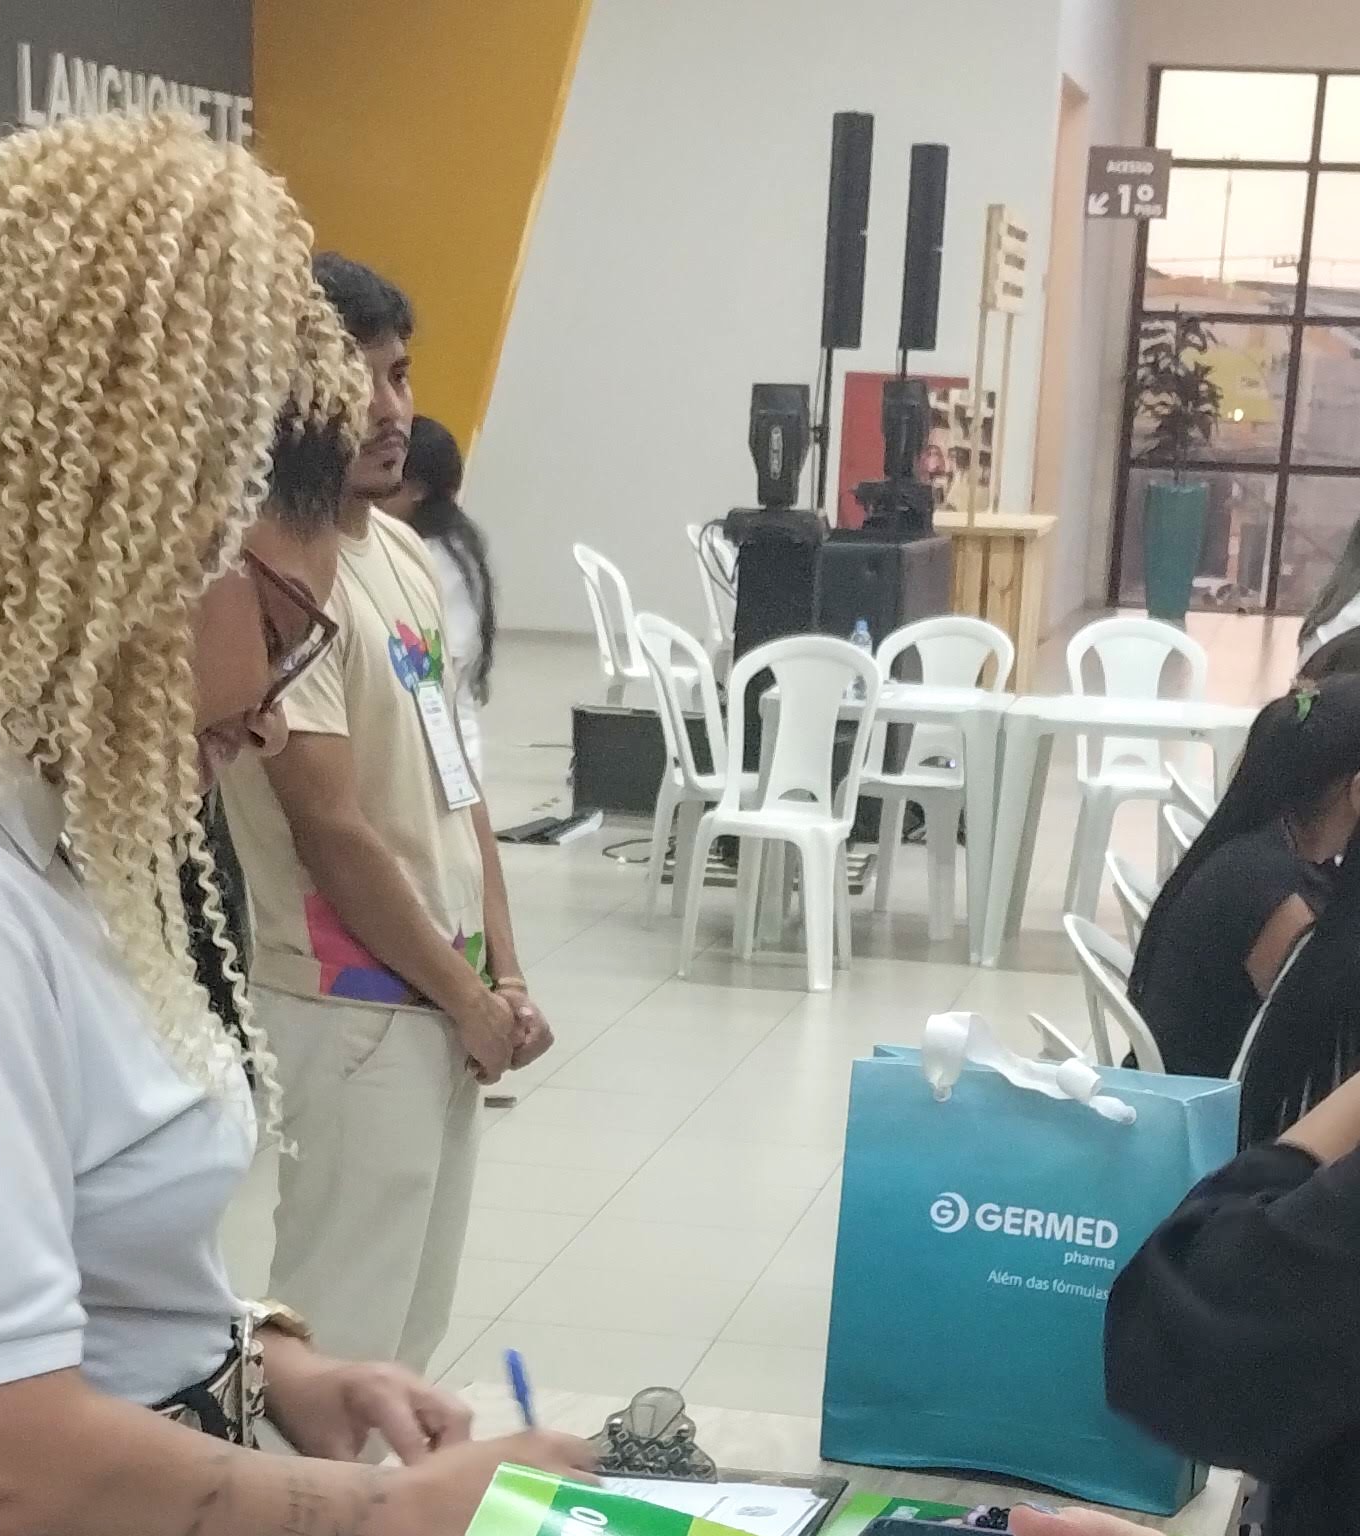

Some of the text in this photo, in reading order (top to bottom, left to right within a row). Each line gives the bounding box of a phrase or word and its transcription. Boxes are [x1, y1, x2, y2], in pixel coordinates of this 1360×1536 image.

[975, 1202, 1119, 1249] GERMED
[1064, 1251, 1116, 1270] pharma
[987, 1269, 1110, 1300] Além das fórmulas
